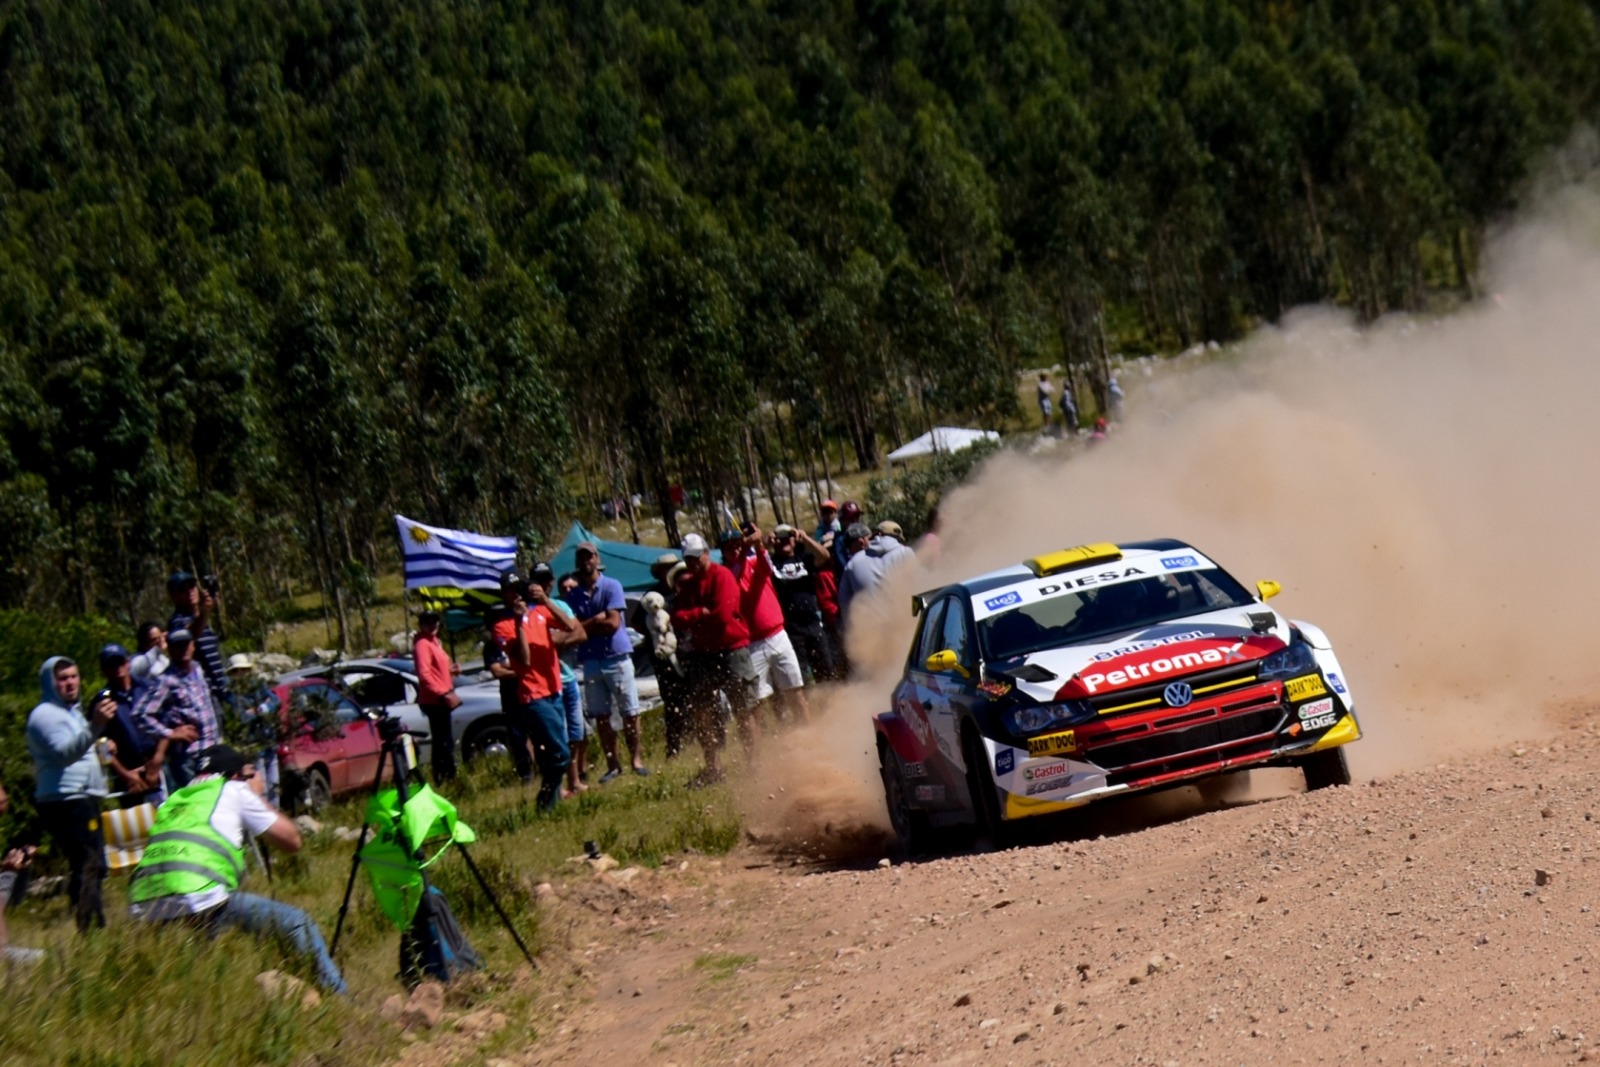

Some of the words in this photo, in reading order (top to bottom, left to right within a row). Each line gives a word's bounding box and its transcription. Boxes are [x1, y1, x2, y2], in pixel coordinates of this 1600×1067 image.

[1038, 567, 1147, 596] DIESA
[1093, 630, 1215, 662] BRISTOL
[1287, 682, 1306, 697] DARK
[1308, 676, 1323, 691] DOG
[1307, 700, 1331, 716] Castrol
[1301, 713, 1337, 731] EDGE
[1028, 736, 1050, 754] DARK
[1056, 734, 1074, 749] DOG
[1034, 763, 1066, 779] Castrol
